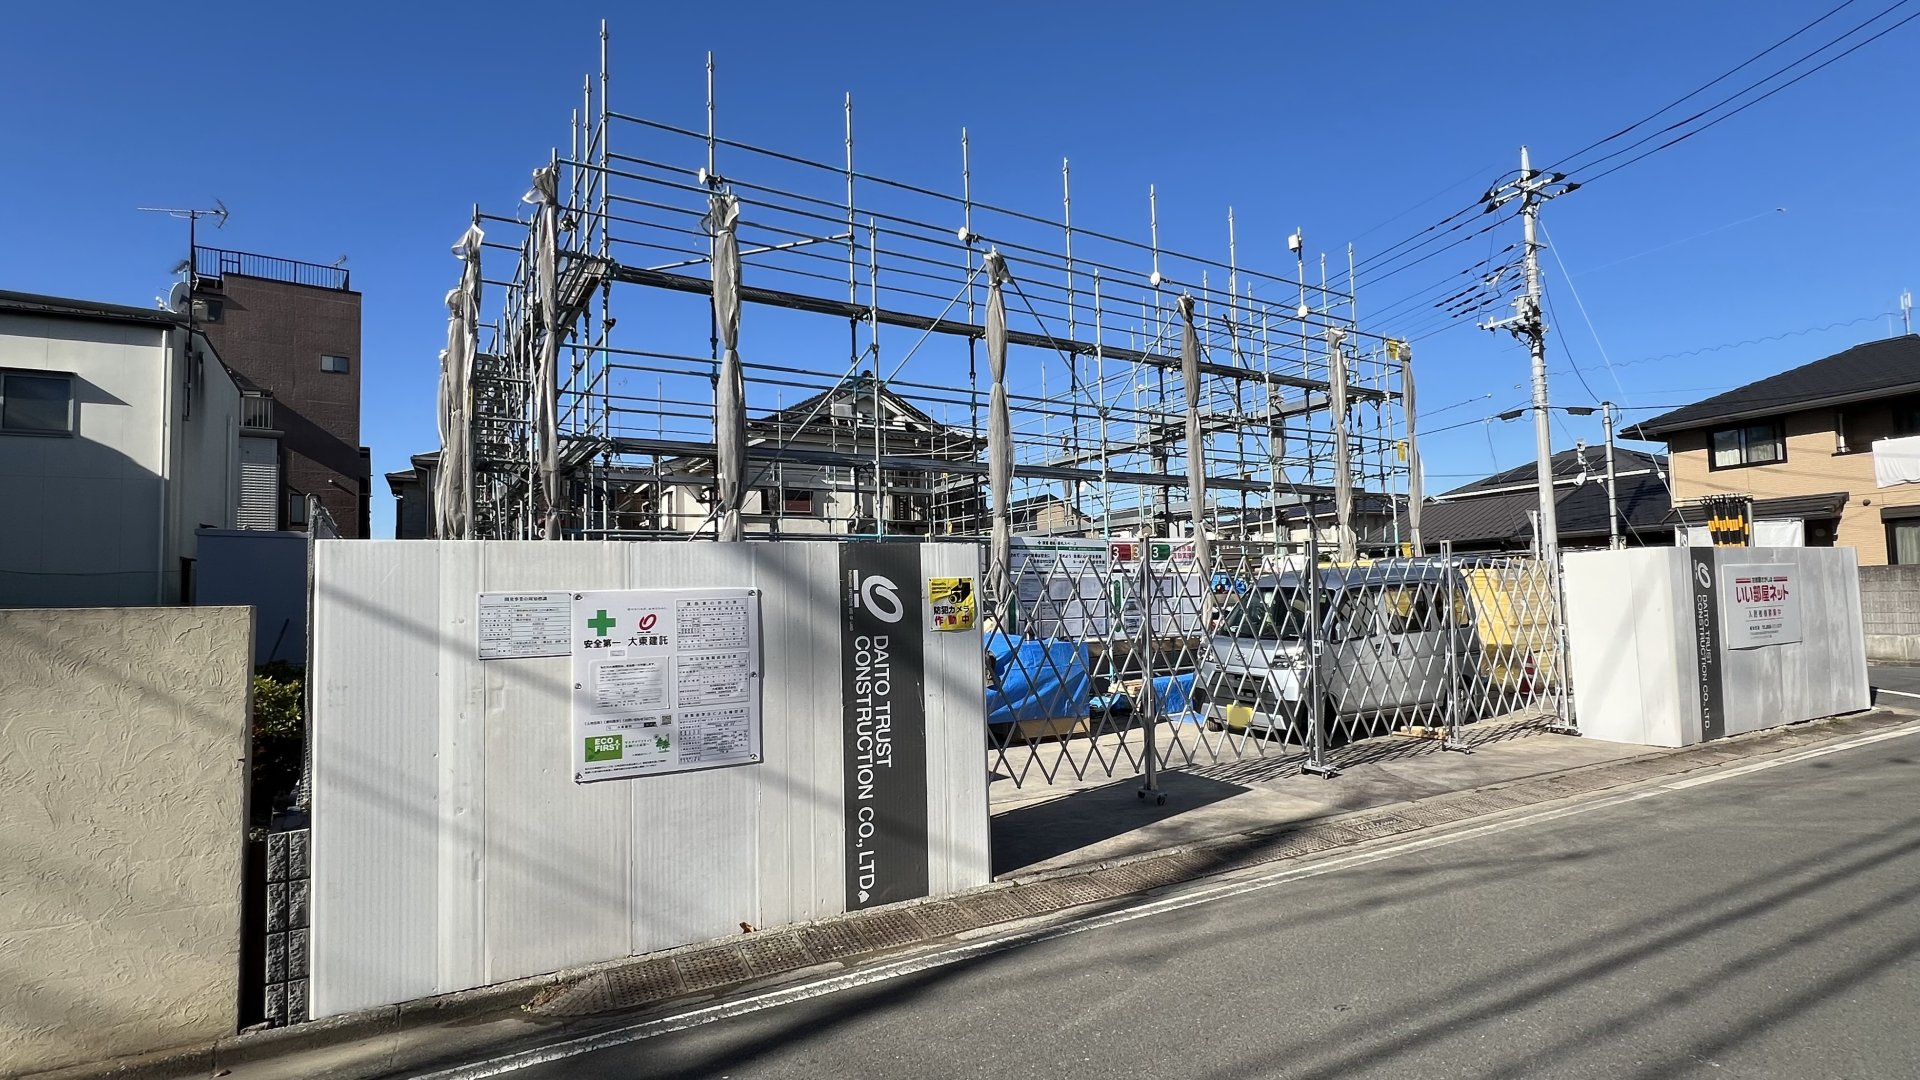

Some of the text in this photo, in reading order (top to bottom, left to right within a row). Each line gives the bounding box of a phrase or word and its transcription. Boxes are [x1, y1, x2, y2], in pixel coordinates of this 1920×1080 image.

[1152, 547, 1159, 558] 3
[1735, 584, 1789, 603] いい部屋ネット
[933, 605, 970, 615] 防犯カメラ
[1702, 594, 1710, 627] DAITO
[583, 638, 621, 649] 安全第一
[627, 635, 669, 647] 大東建託
[1696, 594, 1707, 682] CONSTRUCTION
[873, 635, 892, 768] DAITO TRUST
[854, 635, 874, 800] CONSTRUCTION
[594, 737, 614, 745] ECO
[594, 742, 621, 752] FIRST
[855, 806, 875, 848] CO.,
